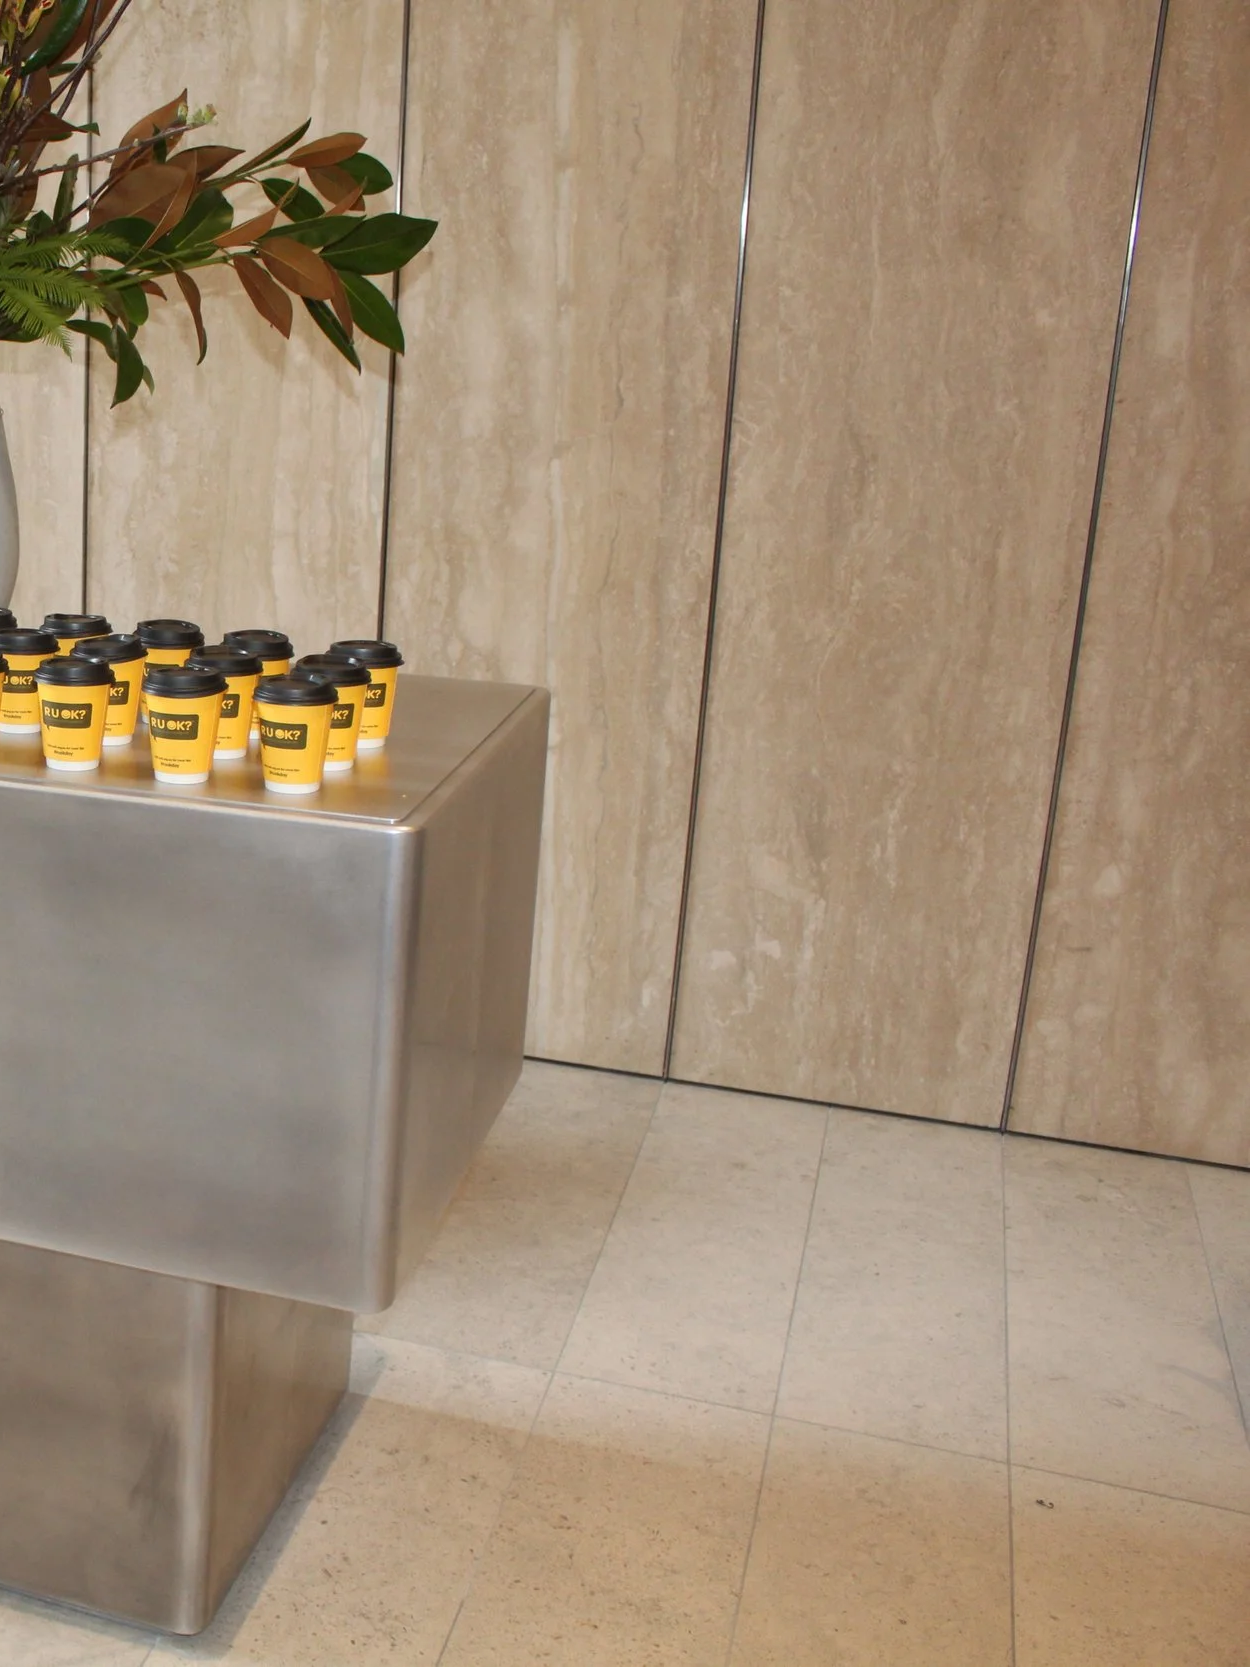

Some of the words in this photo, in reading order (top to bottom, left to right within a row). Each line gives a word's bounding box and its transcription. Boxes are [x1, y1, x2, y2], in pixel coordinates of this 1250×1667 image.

[110, 687, 124, 697] K?
[366, 689, 381, 699] K?
[44, 706, 51, 717] R
[51, 708, 59, 718] U
[331, 710, 349, 720] K?
[151, 716, 157, 728] R
[157, 718, 165, 729] U
